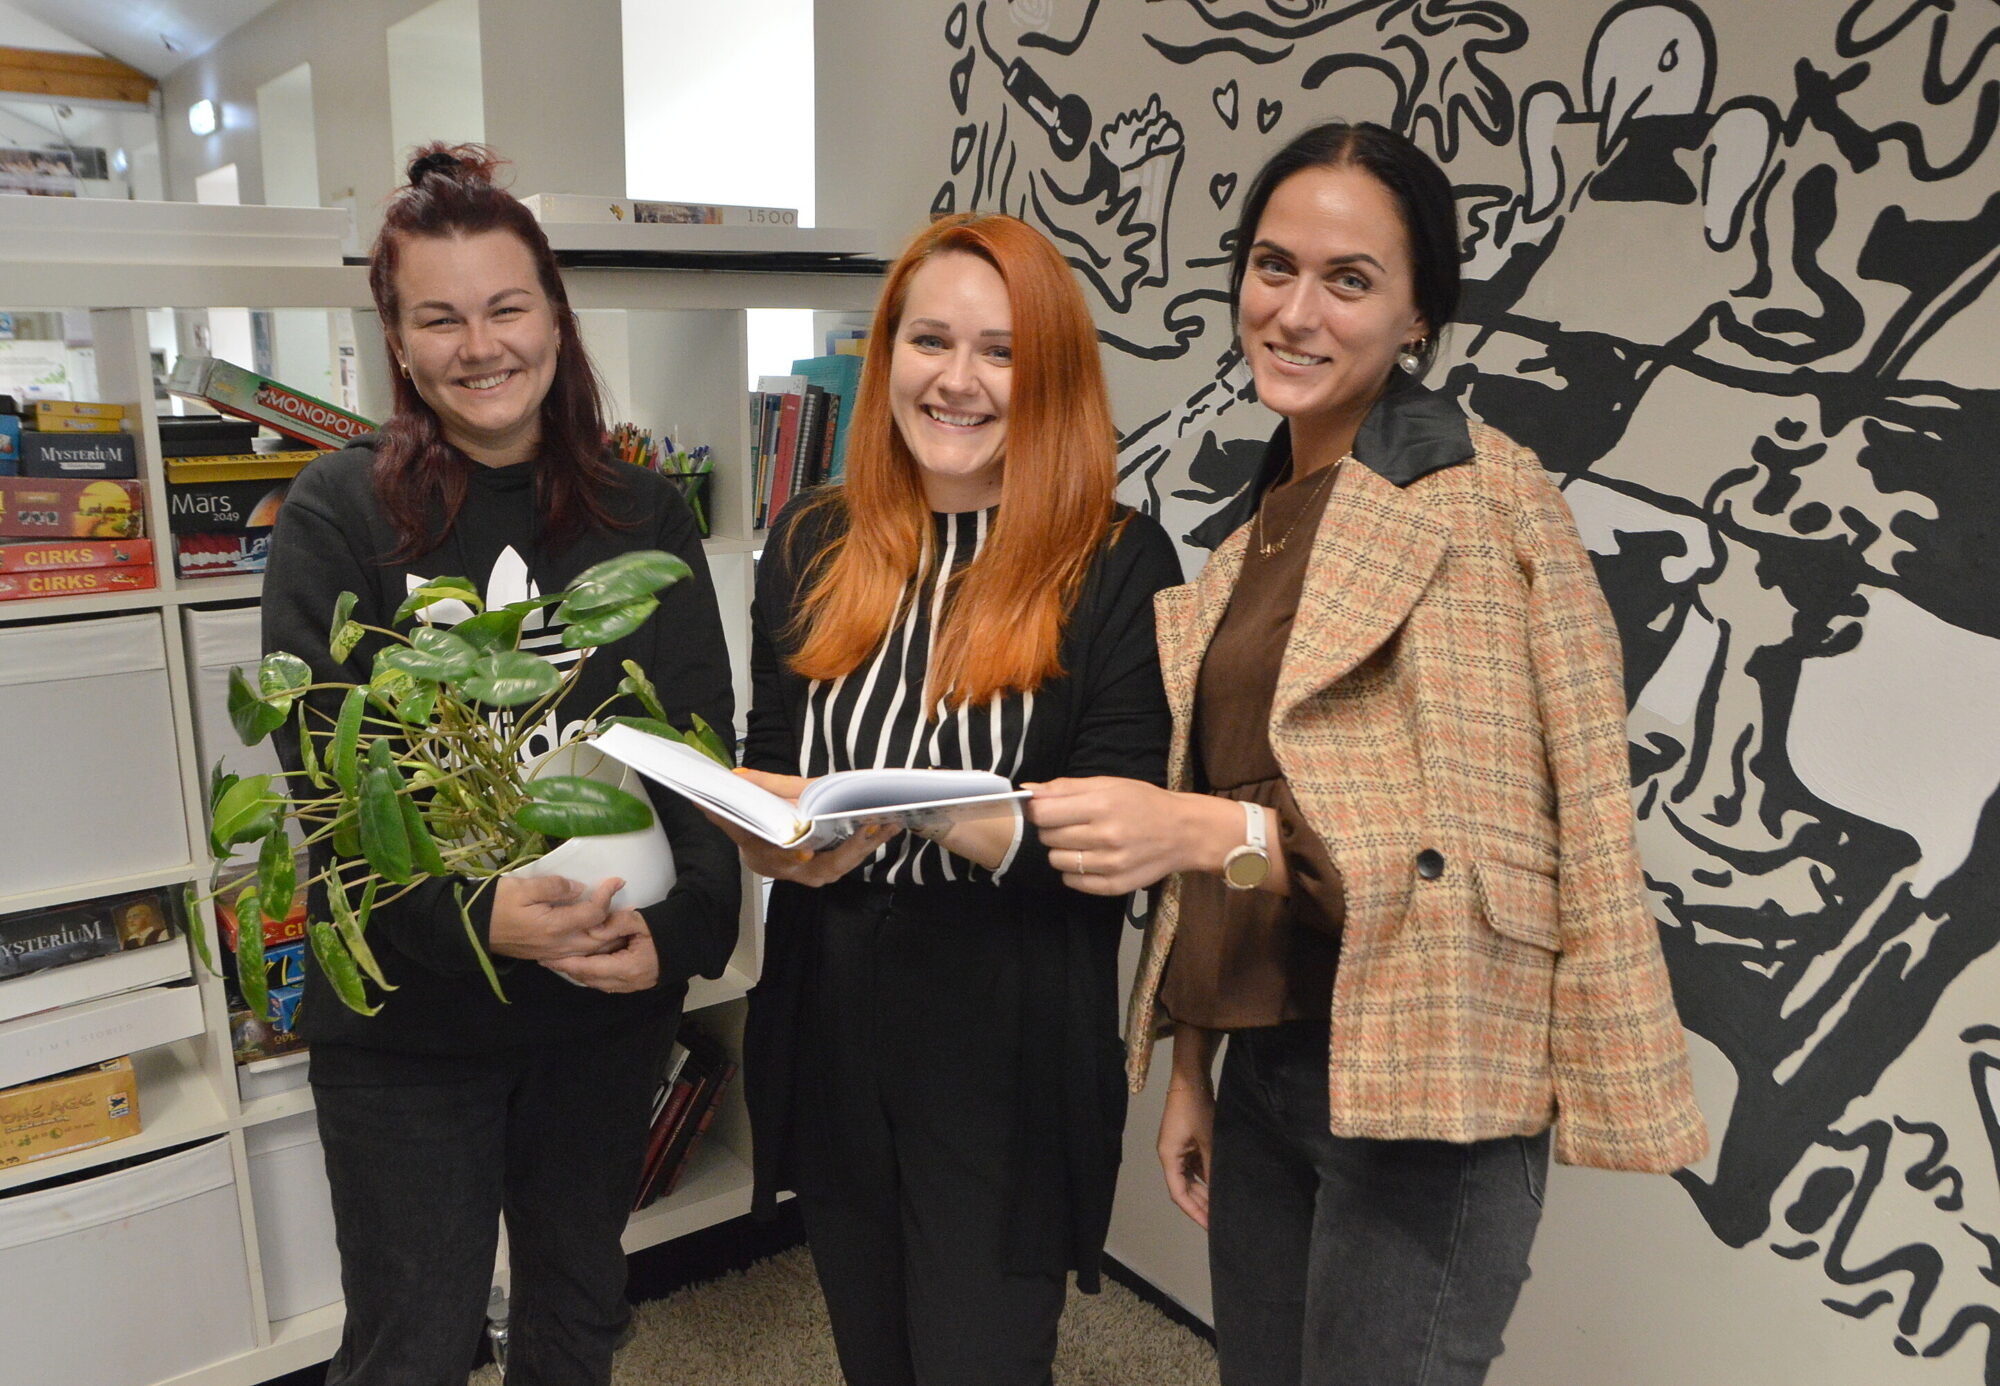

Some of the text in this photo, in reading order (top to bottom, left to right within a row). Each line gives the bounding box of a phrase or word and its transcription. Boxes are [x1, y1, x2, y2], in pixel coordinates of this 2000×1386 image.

[747, 208, 794, 225] 1500
[266, 392, 369, 438] MONOPOLY
[172, 493, 232, 515] Mars
[213, 511, 240, 522] 2049
[24, 548, 94, 567] CIRKS
[28, 573, 97, 592] CIRKS
